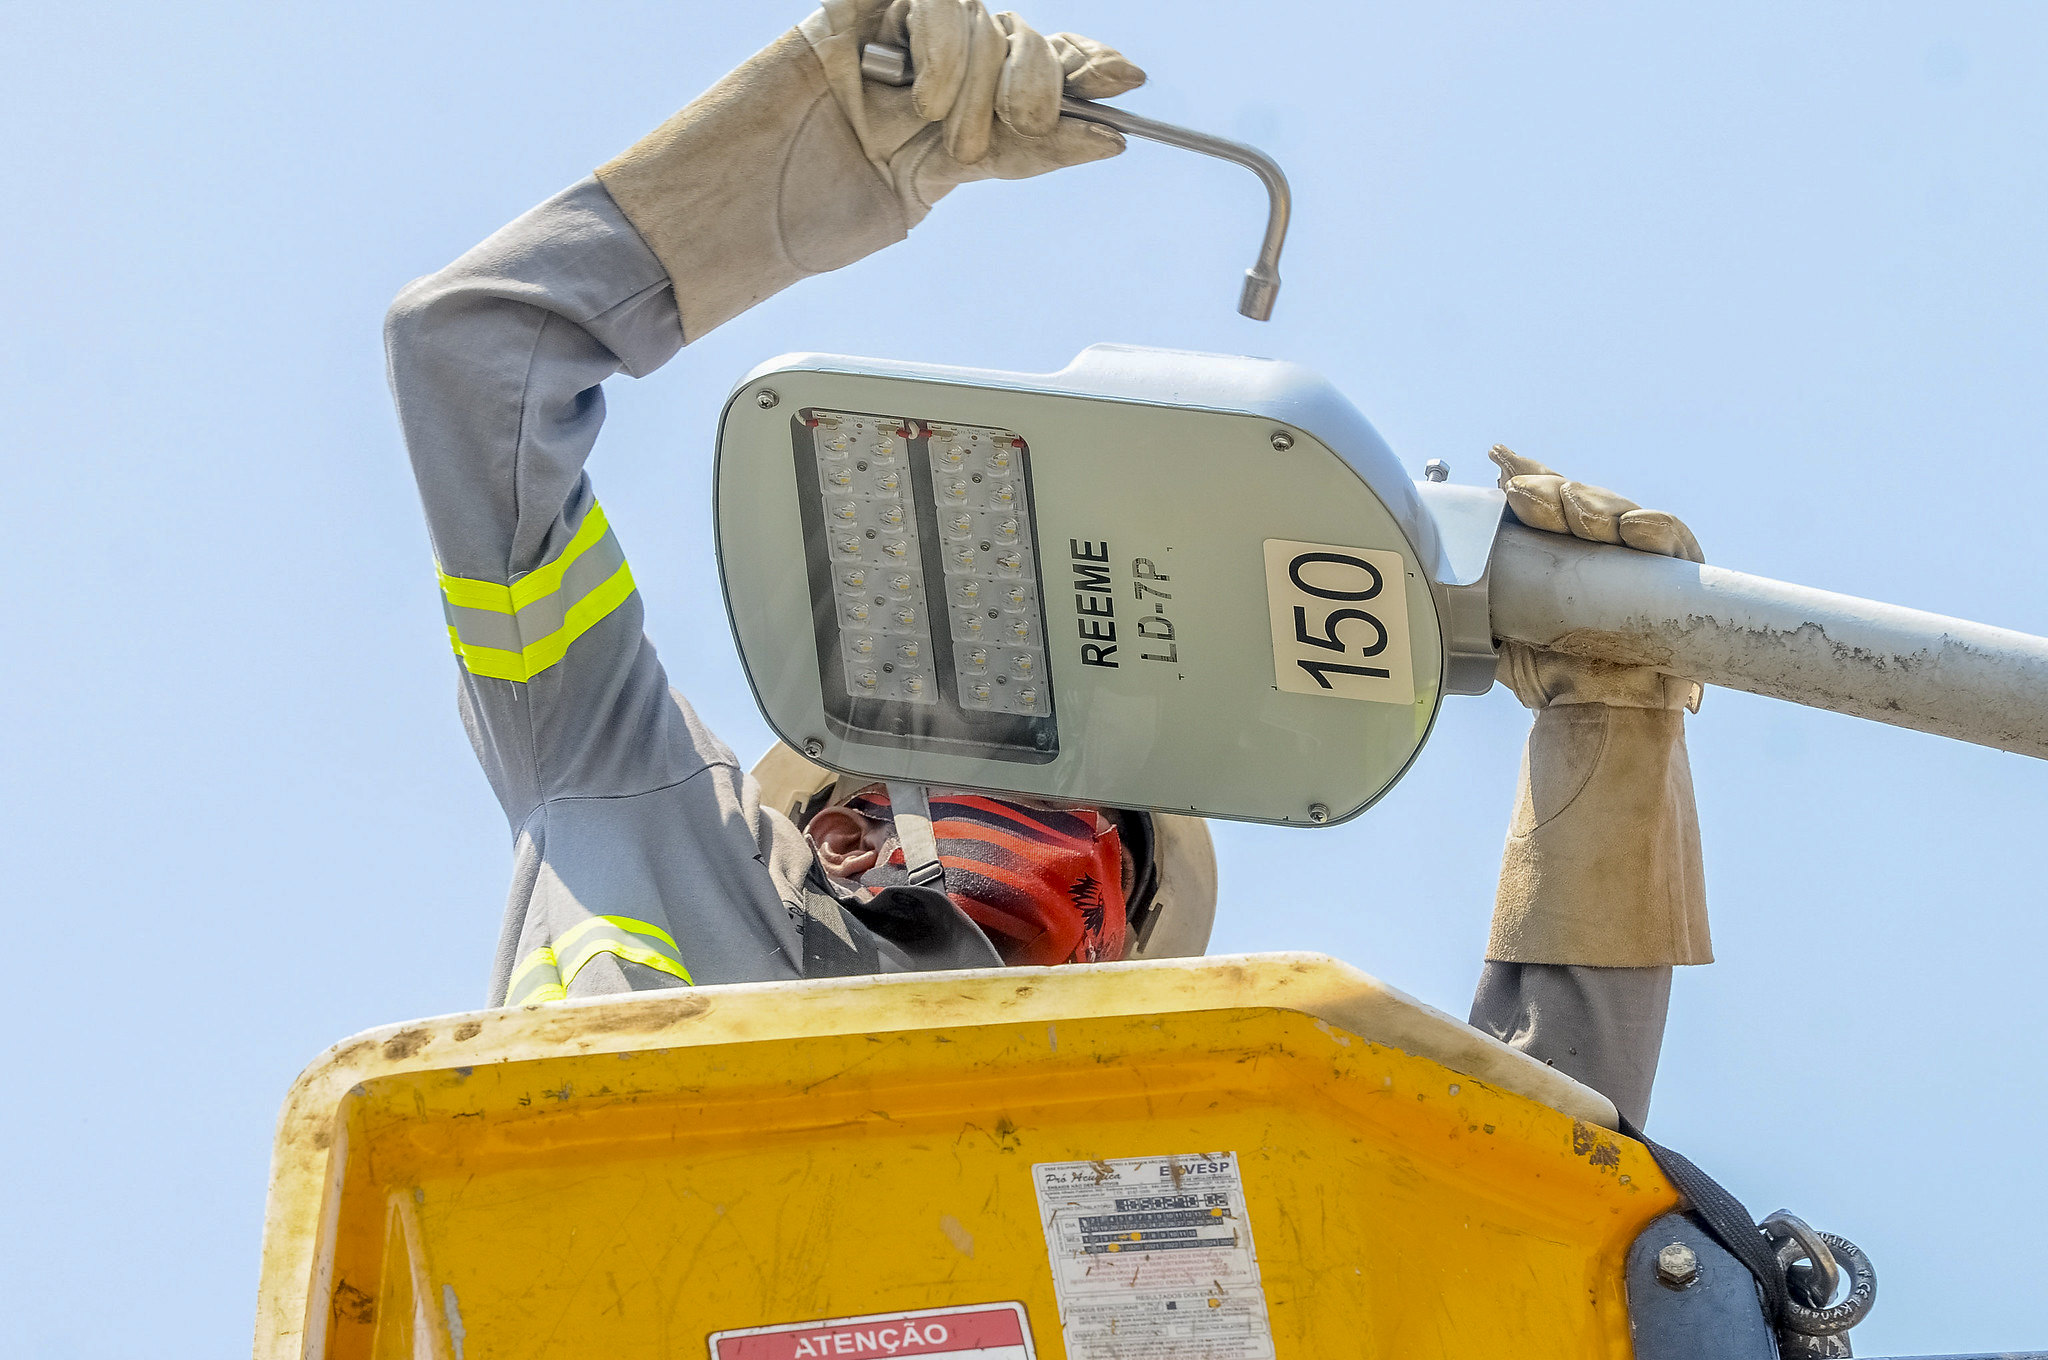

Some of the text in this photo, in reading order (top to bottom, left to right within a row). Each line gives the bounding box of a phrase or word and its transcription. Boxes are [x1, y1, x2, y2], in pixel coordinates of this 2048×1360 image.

[1070, 538, 1119, 669] REEME
[1131, 557, 1179, 663] LD-7P
[1288, 552, 1391, 690] 150
[1160, 1162, 1230, 1176] EVESP
[794, 1322, 948, 1359] ATENÇÃO
